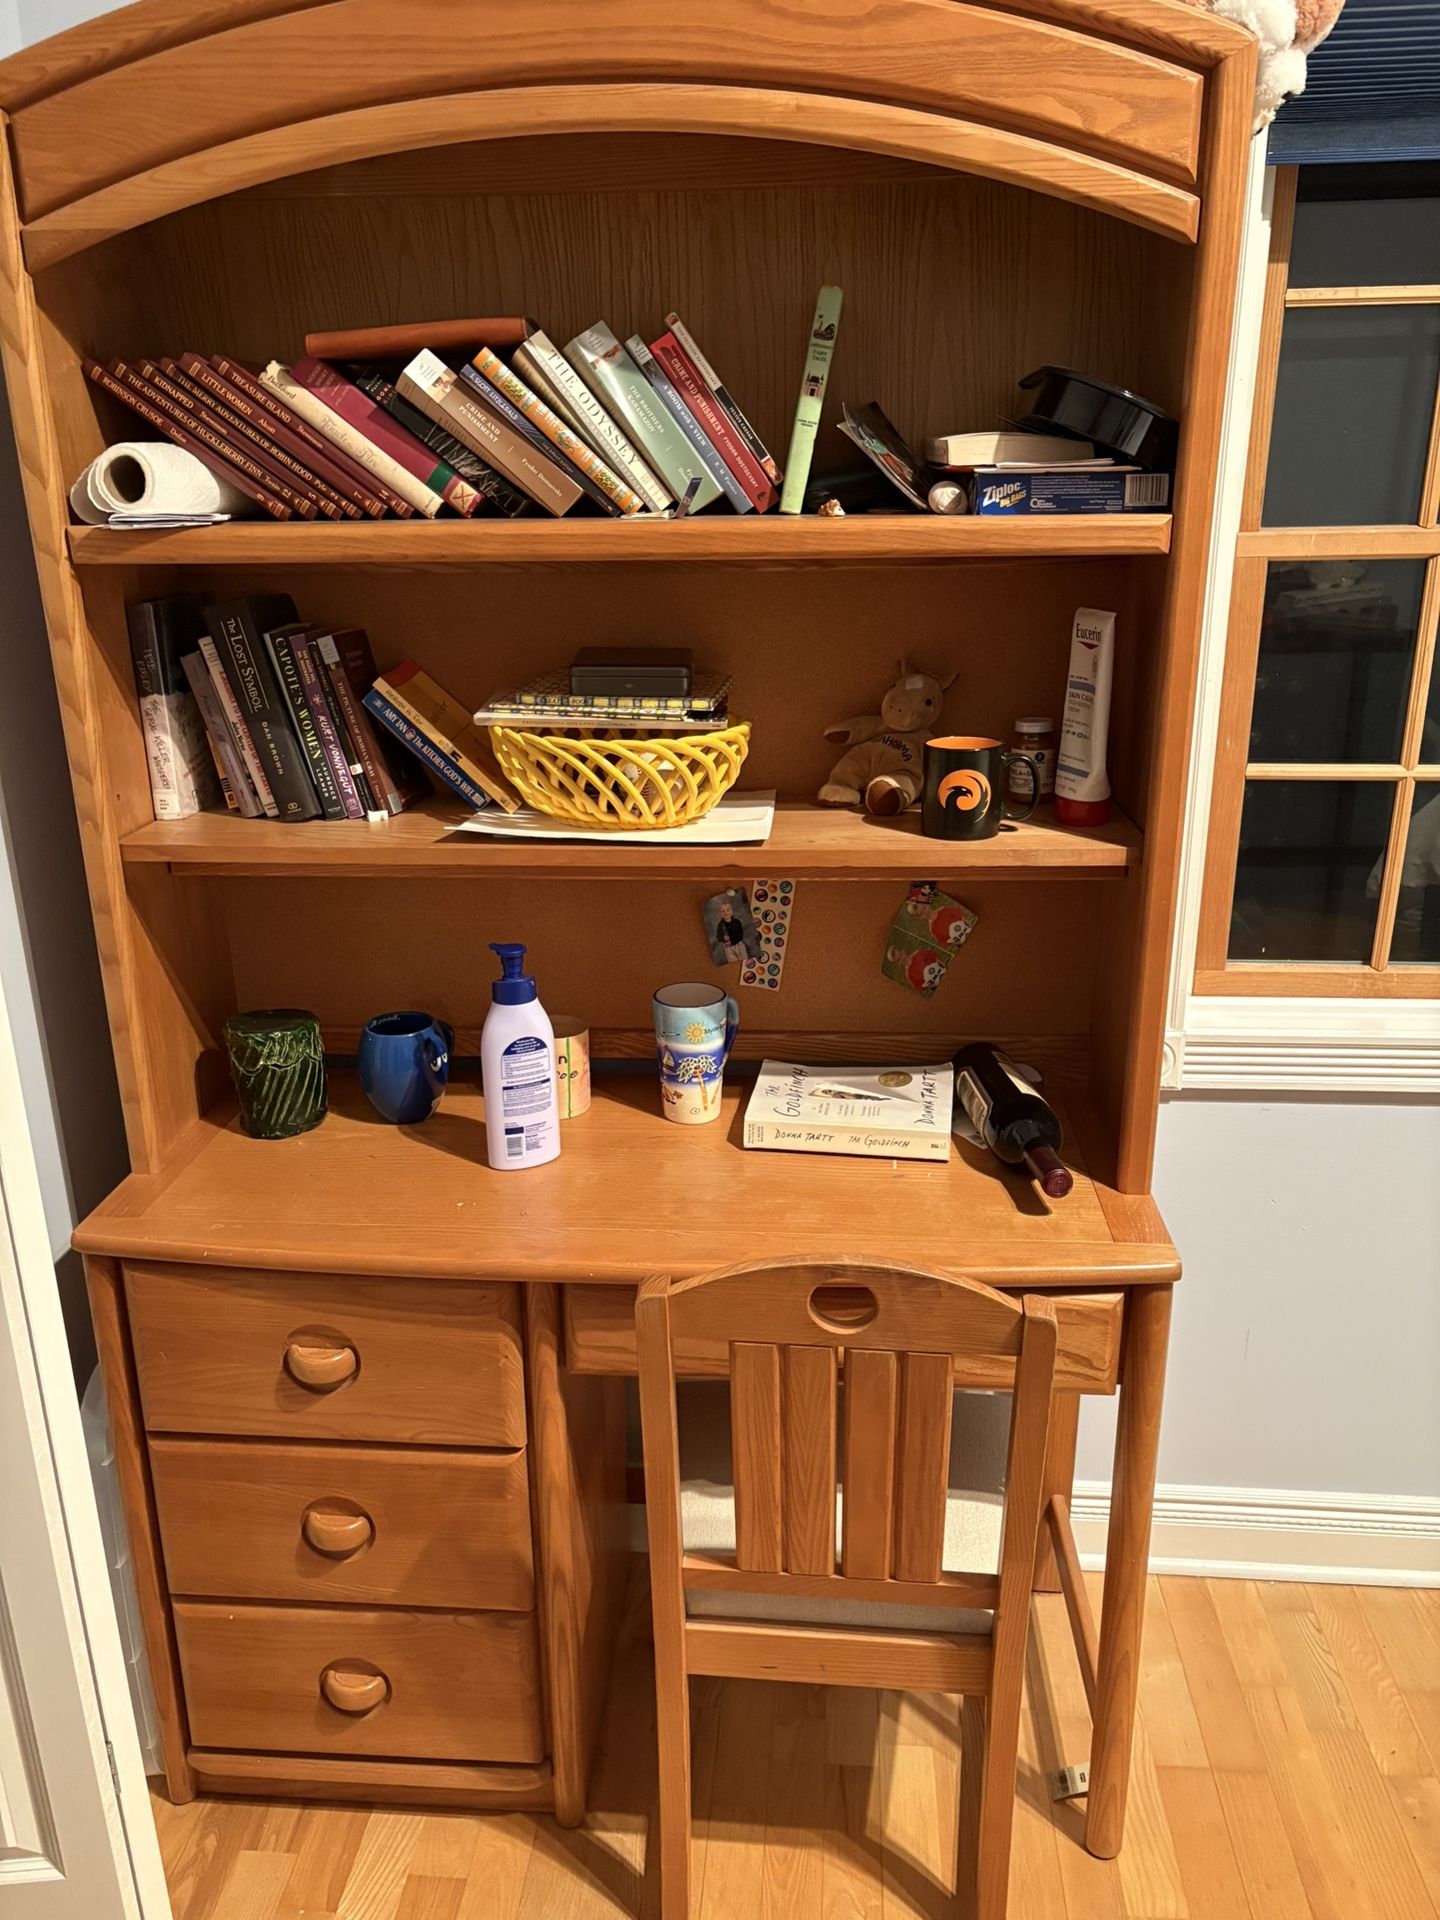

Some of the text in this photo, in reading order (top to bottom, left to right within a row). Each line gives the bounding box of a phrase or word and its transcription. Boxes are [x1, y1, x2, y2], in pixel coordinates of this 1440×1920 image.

[102, 376, 187, 443] ROBINSON CRUSOE Defoe
[154, 376, 228, 435] KIDNAPPED Stevenson
[201, 373, 277, 434] LITTLE WOMEN Alcott
[230, 372, 269, 405] TREASURE
[265, 399, 291, 424] ISLAND
[296, 425, 324, 449] Stevenson
[466, 402, 501, 435] CRIME AND
[473, 376, 491, 393] SCOTT
[489, 389, 519, 421] FITZGERALD
[547, 349, 575, 390] THE
[578, 391, 639, 466] ODYSSEY
[627, 394, 656, 433] KARAMAZOV
[630, 385, 665, 434] THE BROTHERS
[671, 358, 689, 381] CRIME
[685, 380, 698, 395] AND
[694, 393, 725, 436] PUNISHMENT
[722, 436, 737, 456] FYODOR
[128, 374, 280, 491] THE ADVENTURES OF HUCKLEBERRY FINN Twain
[177, 376, 328, 492] THE MERRY ADVENTURES OF ROBIN HOOD Pyle
[458, 406, 499, 443] PUNISHMENT
[667, 390, 682, 411] ROOM
[680, 410, 691, 424] with
[693, 427, 706, 446] VIEW
[724, 475, 738, 496] Forster
[729, 406, 754, 441] JULIUS CAESAR
[982, 481, 1021, 507] Ziploc
[1075, 622, 1102, 642] Eucerin
[226, 618, 264, 713] The LOST SYMBOL
[300, 649, 308, 659] GOD
[304, 658, 313, 673] BLESS
[275, 637, 323, 760] CAPOTE'S WOMEN
[337, 681, 346, 694] THE
[341, 695, 354, 723] PICTURE
[153, 734, 171, 767] KILLER
[231, 721, 247, 751] Jules Verne
[261, 721, 285, 775] DAN BROWN
[353, 725, 359, 734] OF
[356, 735, 369, 761] DORIAN
[317, 713, 334, 741] KURT
[329, 741, 353, 796] VONNEGUT
[364, 760, 375, 778] GRAY
[383, 707, 398, 722] AMY
[395, 718, 409, 734] TAN
[412, 735, 424, 750] The
[421, 744, 447, 771] KITCHEN
[443, 764, 462, 786] GOD'S
[459, 780, 477, 798] WIFE
[320, 762, 338, 801] LAURENCE
[765, 1084, 781, 1098] THE
[773, 1066, 809, 1118] GOLDFINCH
[913, 1068, 939, 1126] DONNA TARTT
[774, 1127, 802, 1140] DONNA
[804, 1132, 836, 1142] TARTT
[848, 1135, 861, 1144] THE
[864, 1134, 911, 1149] GOLDFINCH
